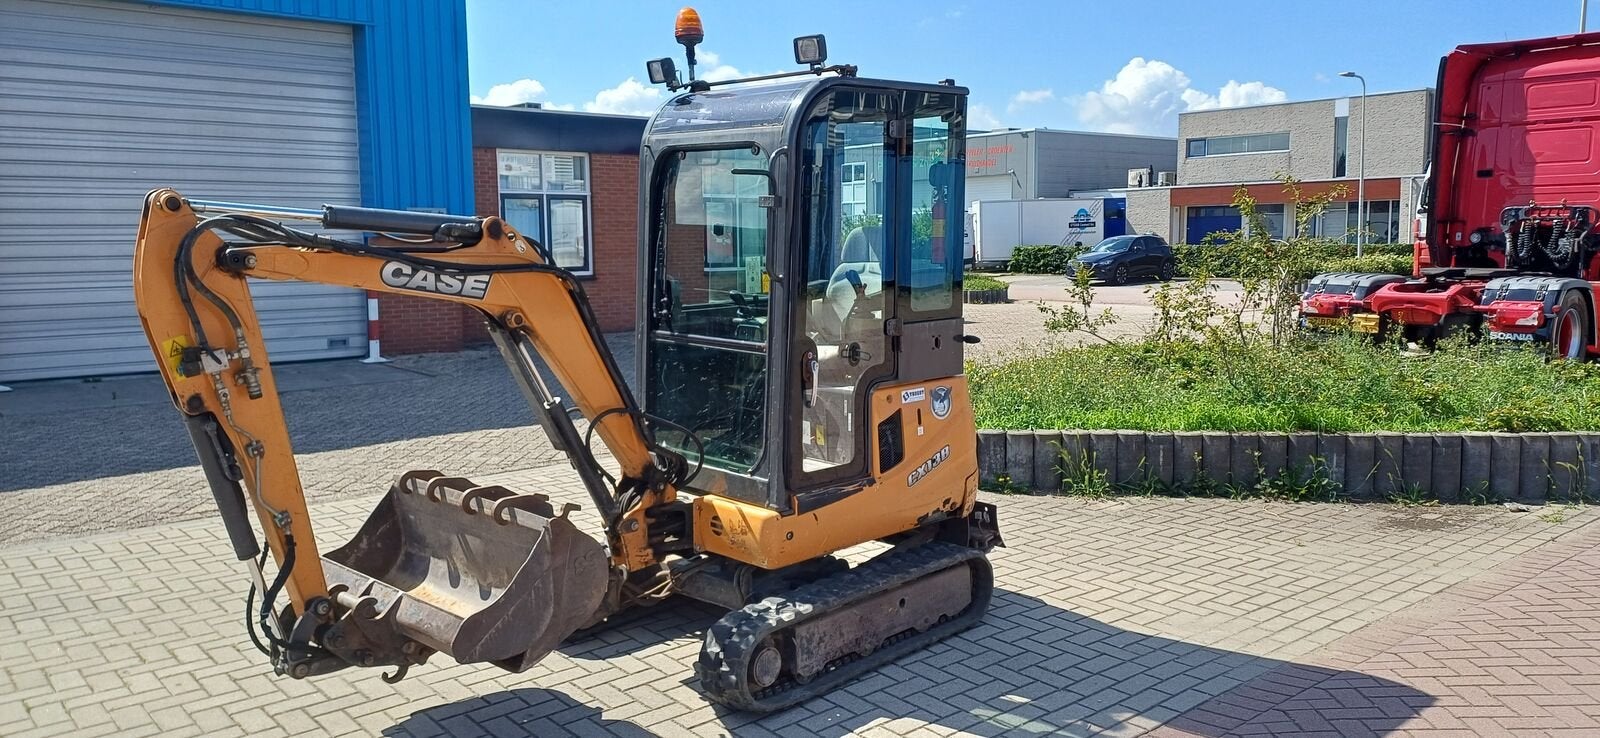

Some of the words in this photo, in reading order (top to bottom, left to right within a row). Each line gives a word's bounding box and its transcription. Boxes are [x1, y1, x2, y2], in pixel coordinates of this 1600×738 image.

[381, 260, 490, 299] CASE
[1490, 331, 1534, 341] SCANIA
[907, 444, 950, 487] CX13B
